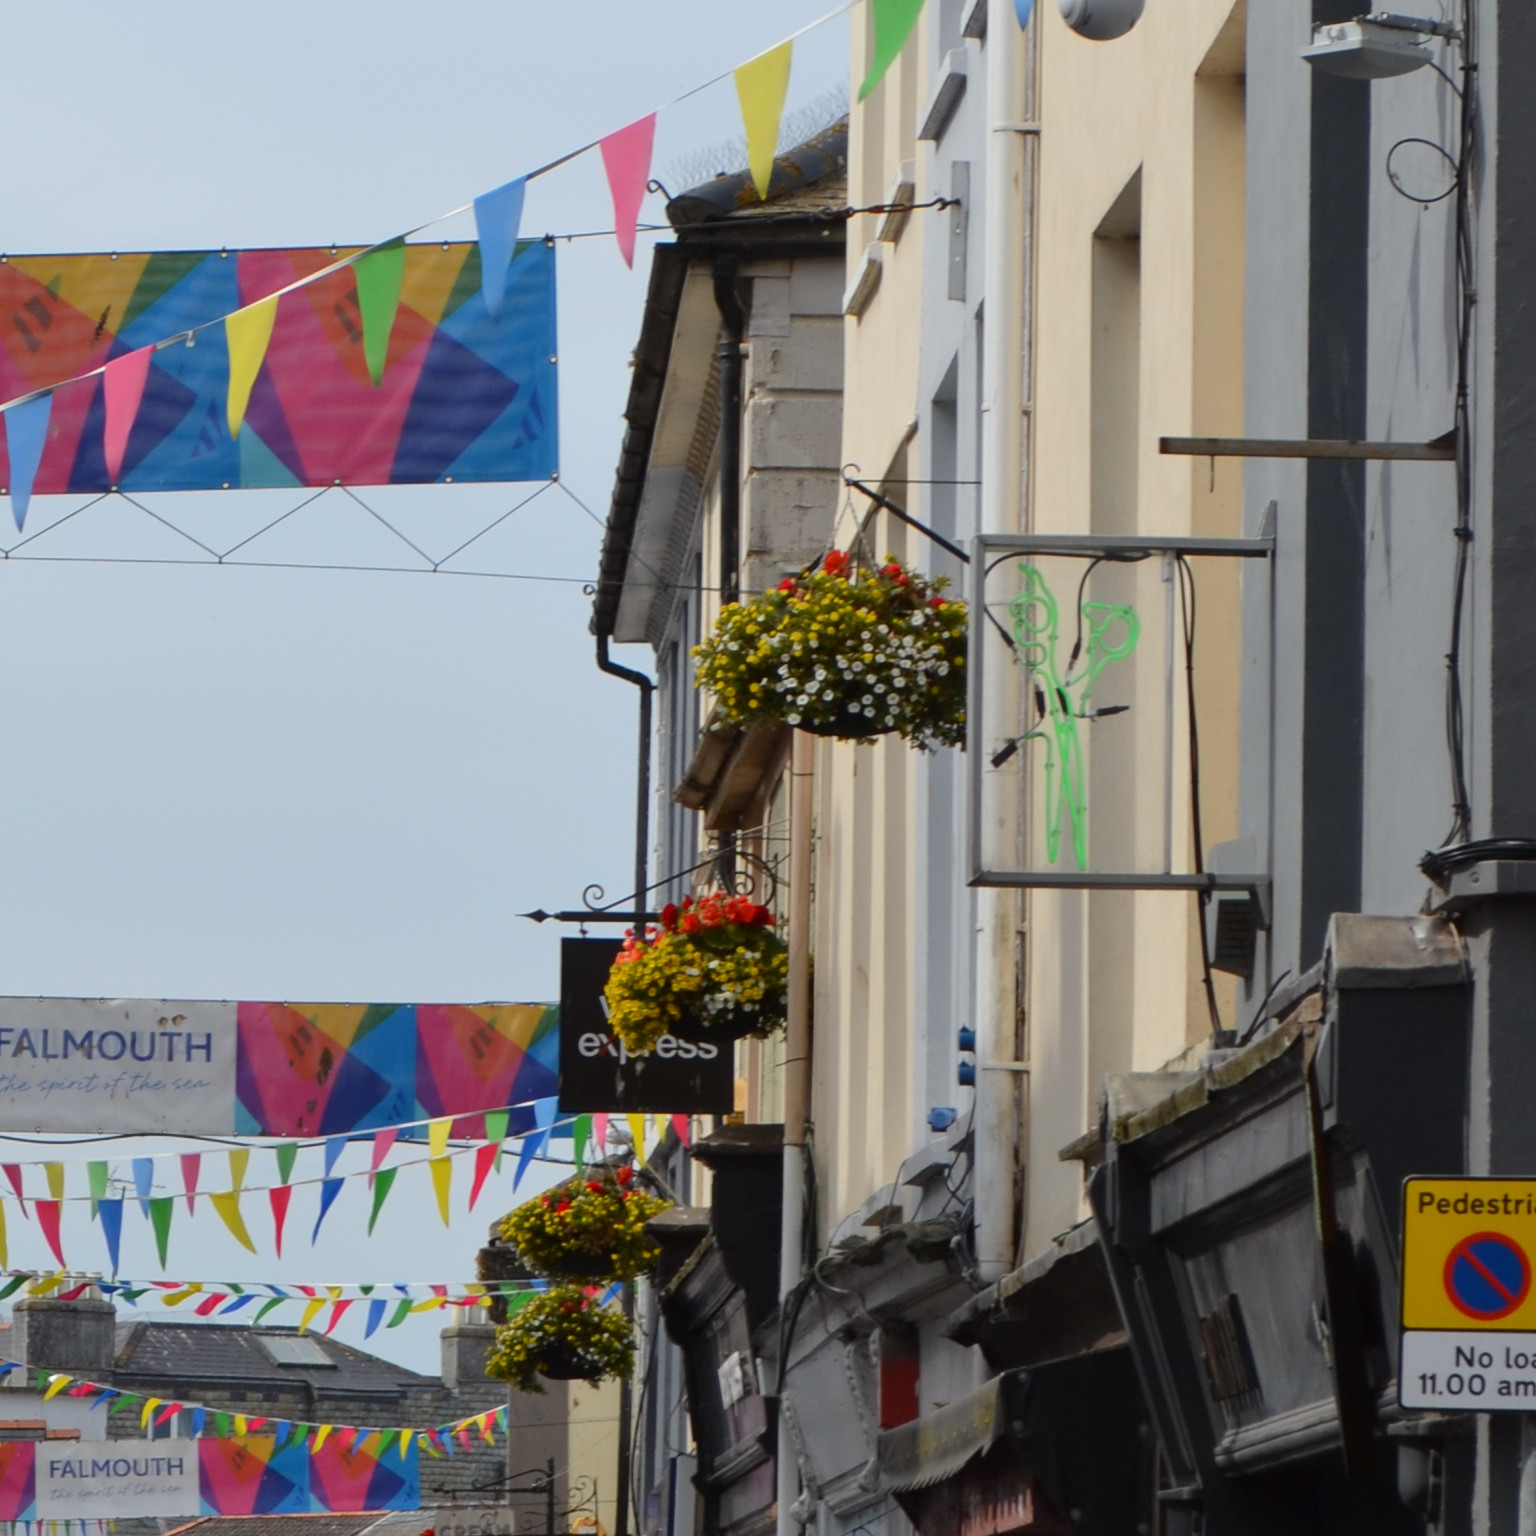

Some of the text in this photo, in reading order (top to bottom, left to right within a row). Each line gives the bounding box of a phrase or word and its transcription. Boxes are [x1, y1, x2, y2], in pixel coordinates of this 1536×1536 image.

[37, 1073, 101, 1099] spirit
[103, 1071, 128, 1092] of
[129, 1072, 166, 1092] the
[172, 1077, 212, 1090] sea
[1418, 1192, 1536, 1215] Pedestri
[1455, 1345, 1494, 1369] No
[1418, 1373, 1536, 1397] 11.00 am
[49, 1457, 184, 1479] FALMOUTH
